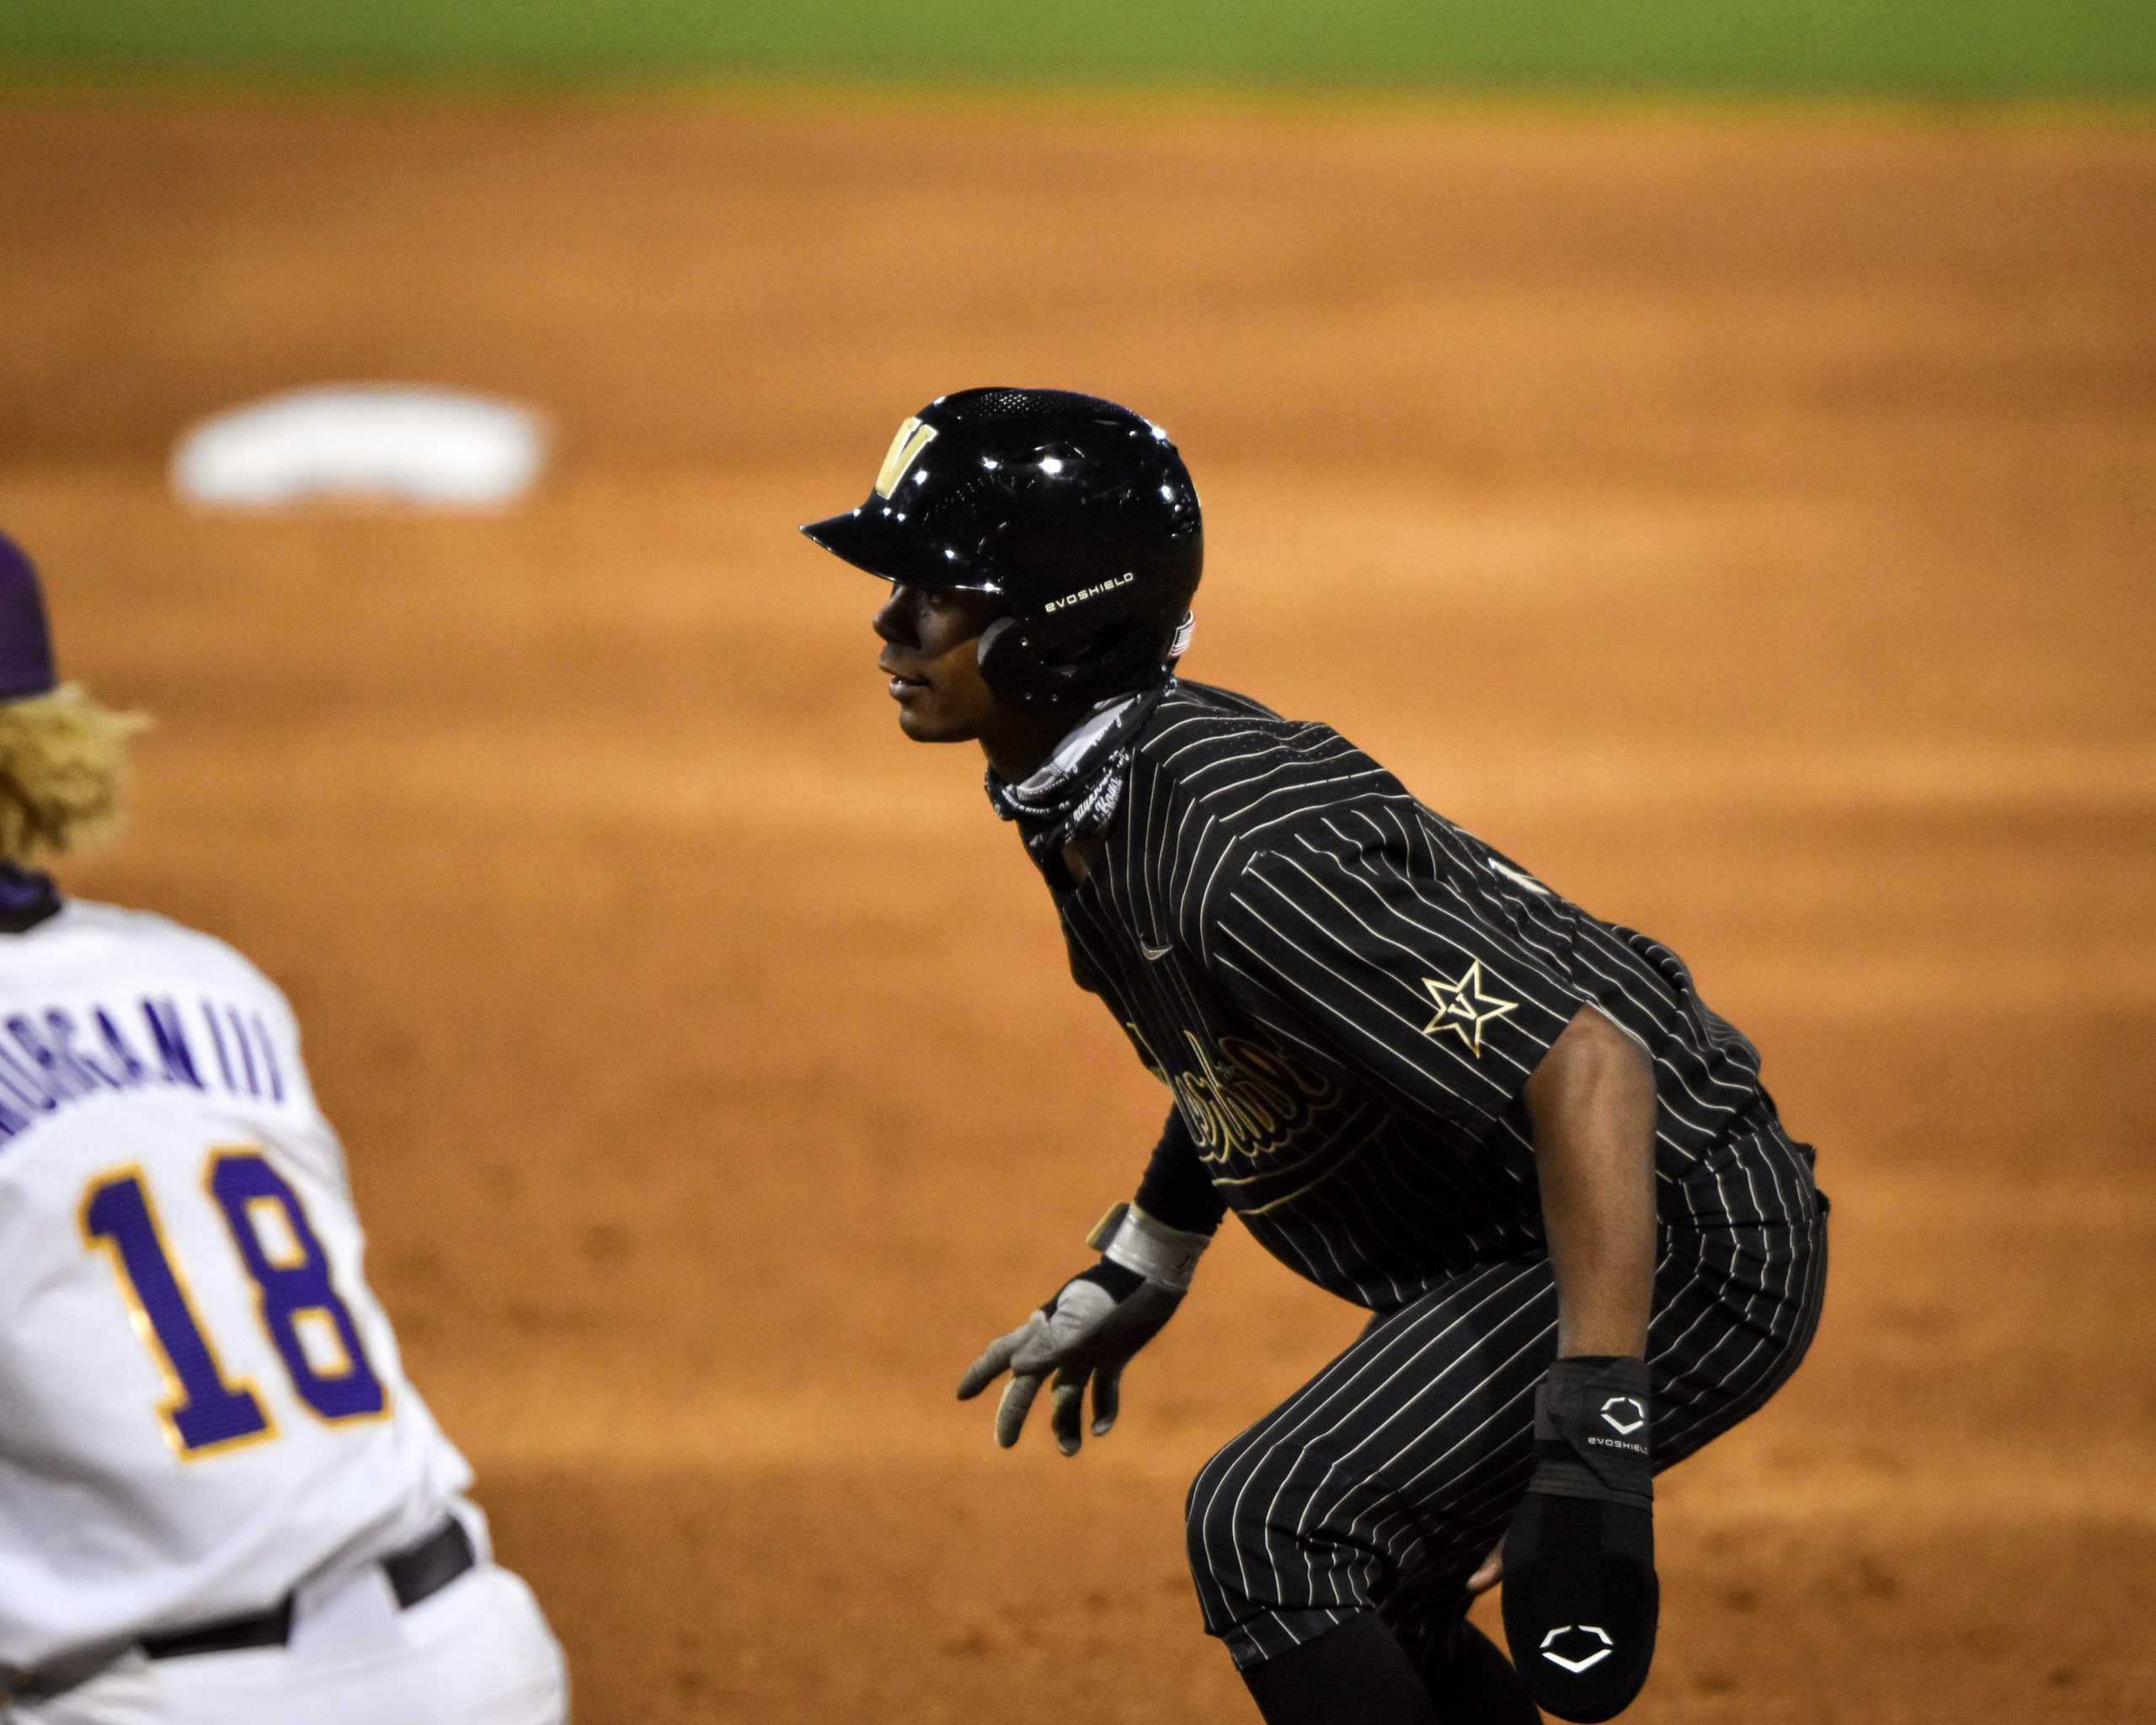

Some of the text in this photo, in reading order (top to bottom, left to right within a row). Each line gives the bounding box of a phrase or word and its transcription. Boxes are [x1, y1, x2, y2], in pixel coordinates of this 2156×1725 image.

[875, 416, 937, 499] V
[1044, 572, 1134, 612] EVOSHIELD
[1447, 992, 1478, 1020] V
[0, 993, 205, 1147] ORGAN
[77, 1143, 393, 1462] 18
